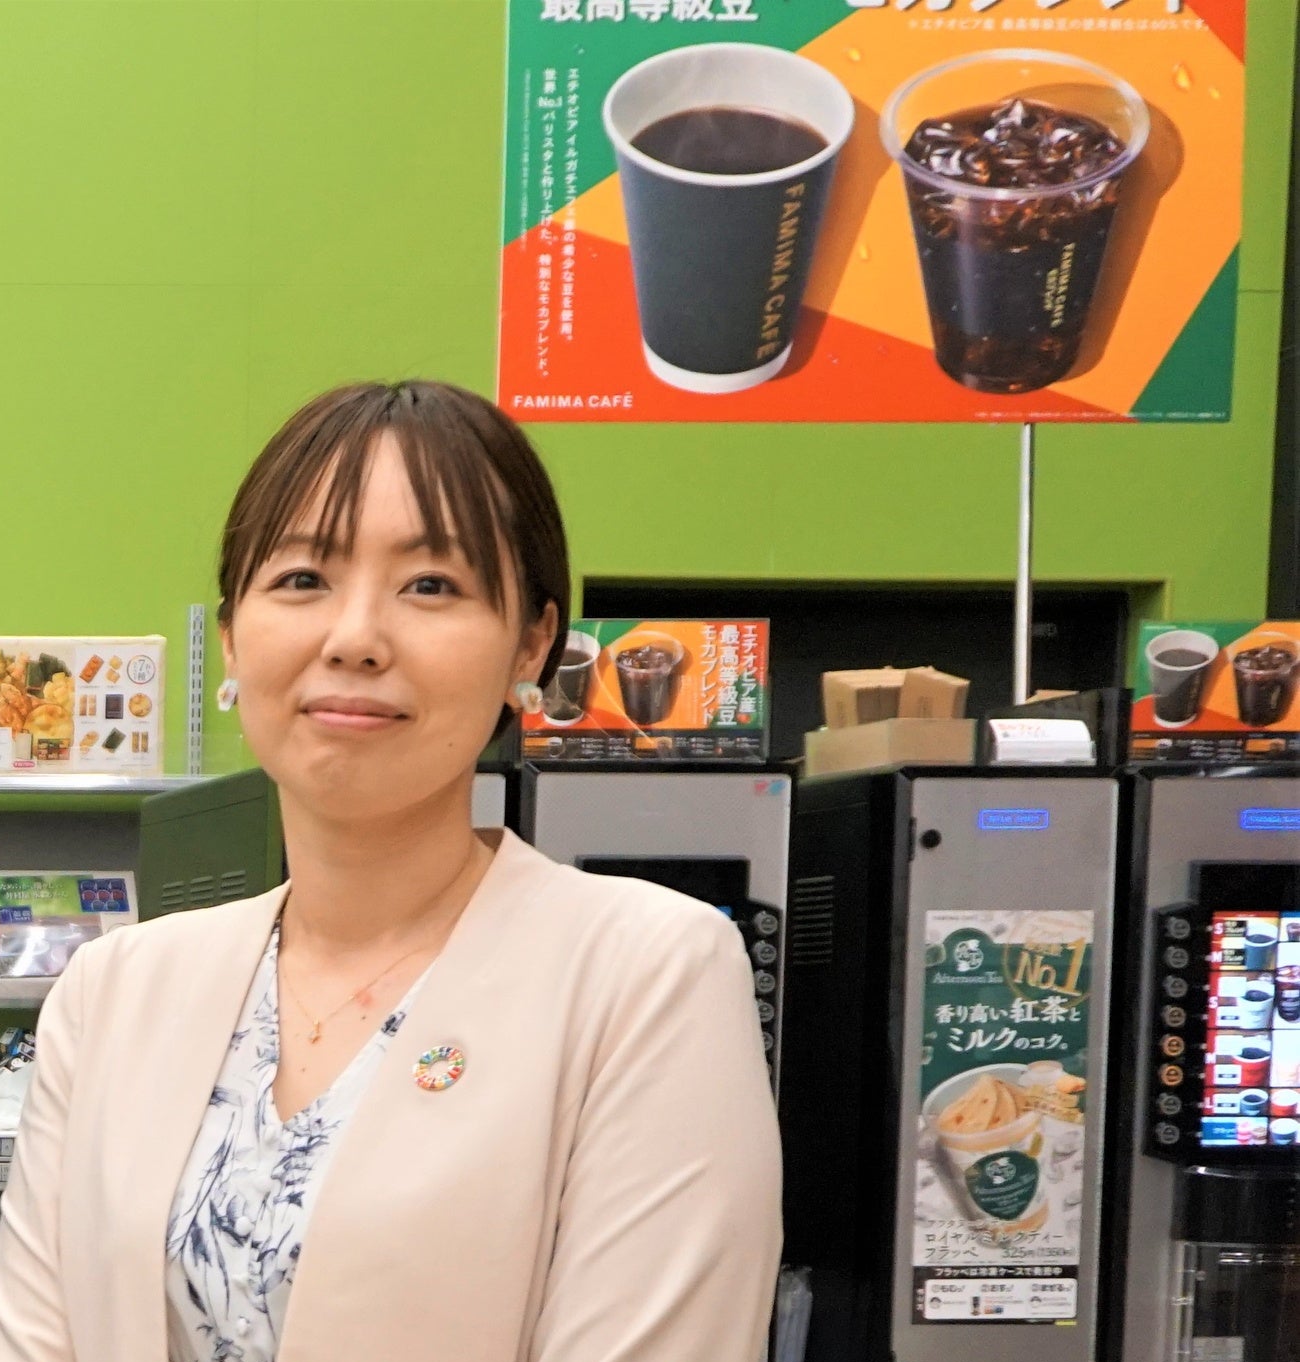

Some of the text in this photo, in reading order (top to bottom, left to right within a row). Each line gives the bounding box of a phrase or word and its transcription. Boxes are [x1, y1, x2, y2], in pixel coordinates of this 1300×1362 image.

[514, 395, 585, 408] FAMIMA
[701, 624, 720, 727] モカブレンド
[716, 624, 740, 727] 最高等級豆
[739, 625, 758, 714] エチオピア産
[936, 995, 1082, 1024] 香り高い紅茶と
[948, 1027, 1069, 1052] ミルクのコク。
